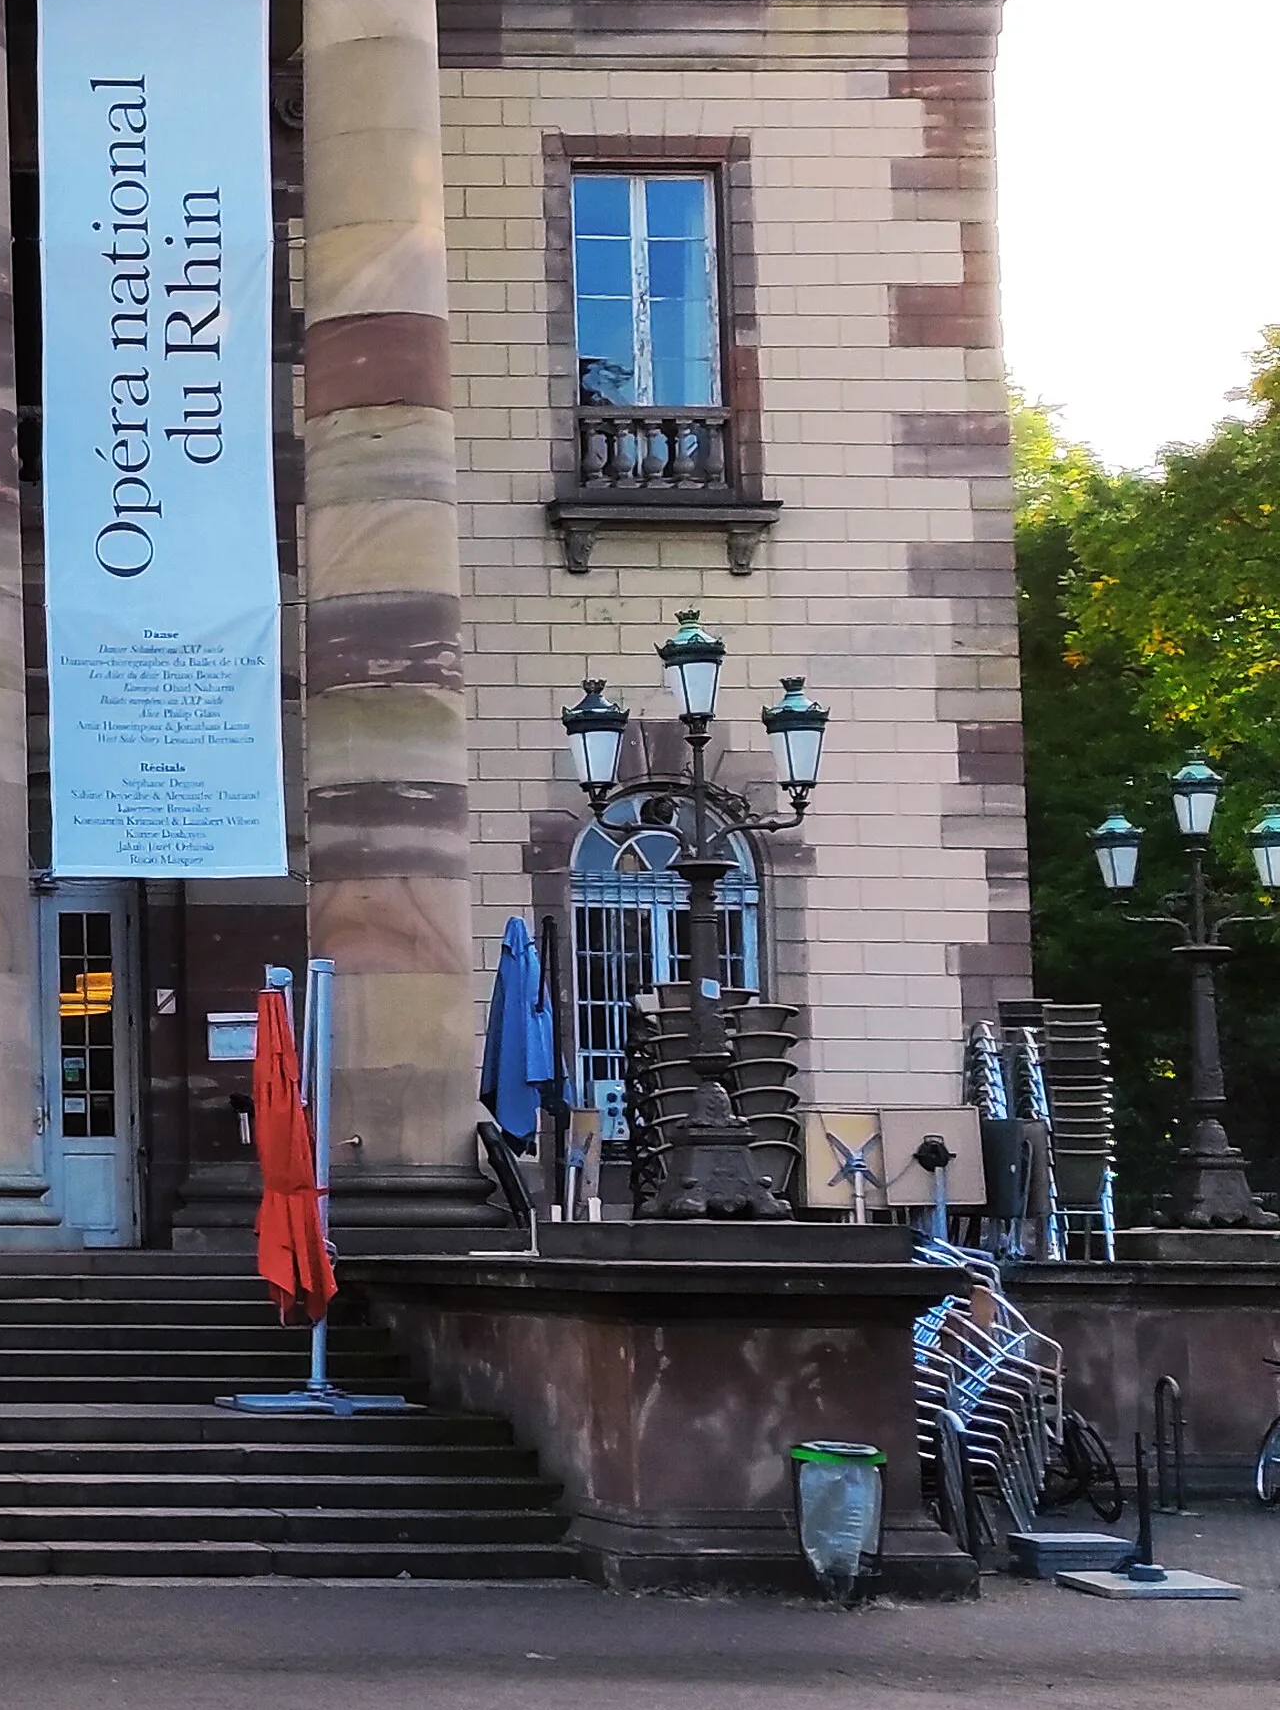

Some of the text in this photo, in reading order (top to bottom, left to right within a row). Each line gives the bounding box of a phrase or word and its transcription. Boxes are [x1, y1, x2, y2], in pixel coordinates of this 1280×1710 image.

[90, 73, 163, 578] Opéra national
[164, 186, 223, 465] du Rhin
[143, 629, 180, 640] Danse
[140, 762, 186, 773] Récitals
